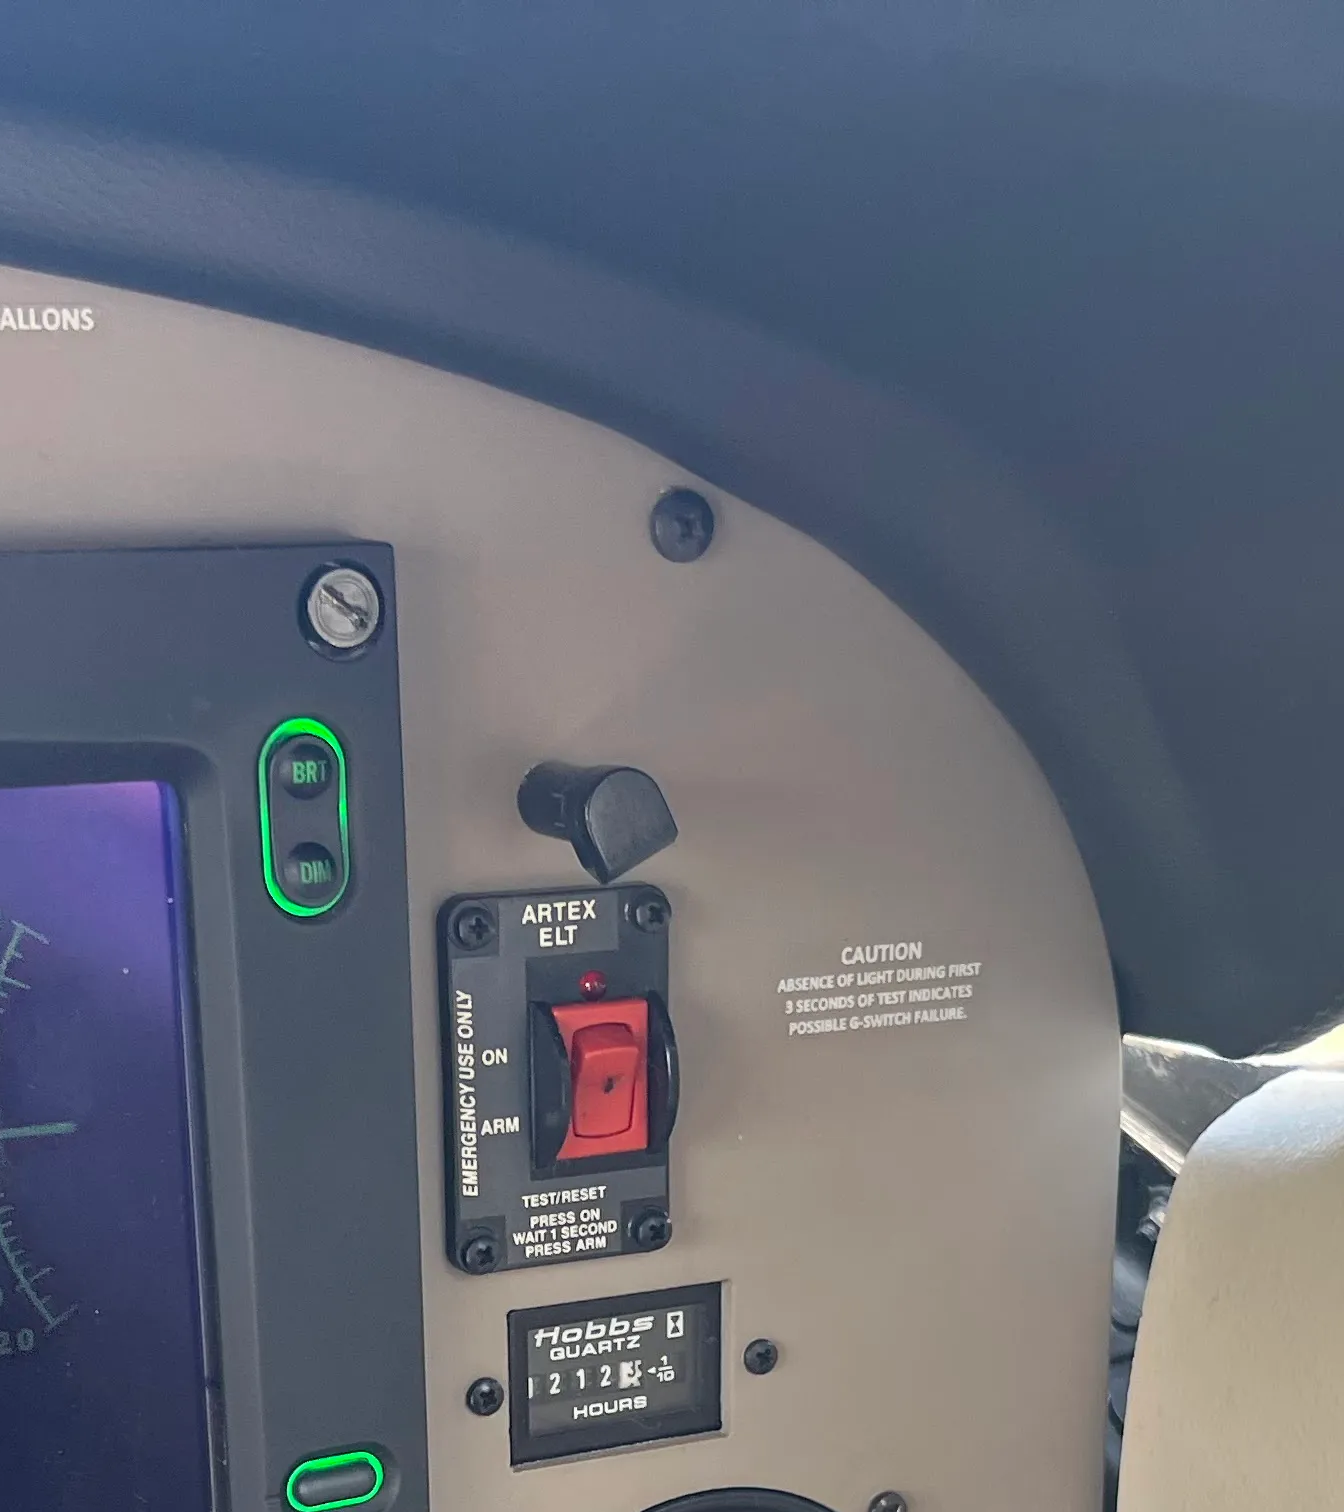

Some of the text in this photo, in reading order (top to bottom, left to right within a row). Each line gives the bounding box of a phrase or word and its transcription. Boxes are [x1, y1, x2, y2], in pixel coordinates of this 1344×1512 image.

[292, 760, 328, 784] BRT
[300, 859, 331, 883] DIM
[521, 900, 596, 925] ARTEX
[539, 925, 578, 947] ELT
[841, 941, 922, 965] CAUTION
[777, 962, 982, 993] ABSENCE OF LIGHT DURING FIRST
[796, 985, 972, 1013] SECONDS OF TEST INDICATES
[789, 1007, 967, 1036] POSSIBLE G-SWITCH FAILURE.
[481, 1049, 508, 1065] ON
[456, 990, 478, 1196] EMERGENCY USE ONLY
[481, 1117, 520, 1136] ARM
[522, 1186, 606, 1208] TEST/RESET
[530, 1208, 600, 1229] PRESS ON
[513, 1220, 617, 1246] WAIT SECOND
[525, 1237, 606, 1258] PRESS ARM
[534, 1316, 655, 1347] Hobbs
[550, 1335, 640, 1360] QUARTZ
[573, 1396, 647, 1420] HOURS
